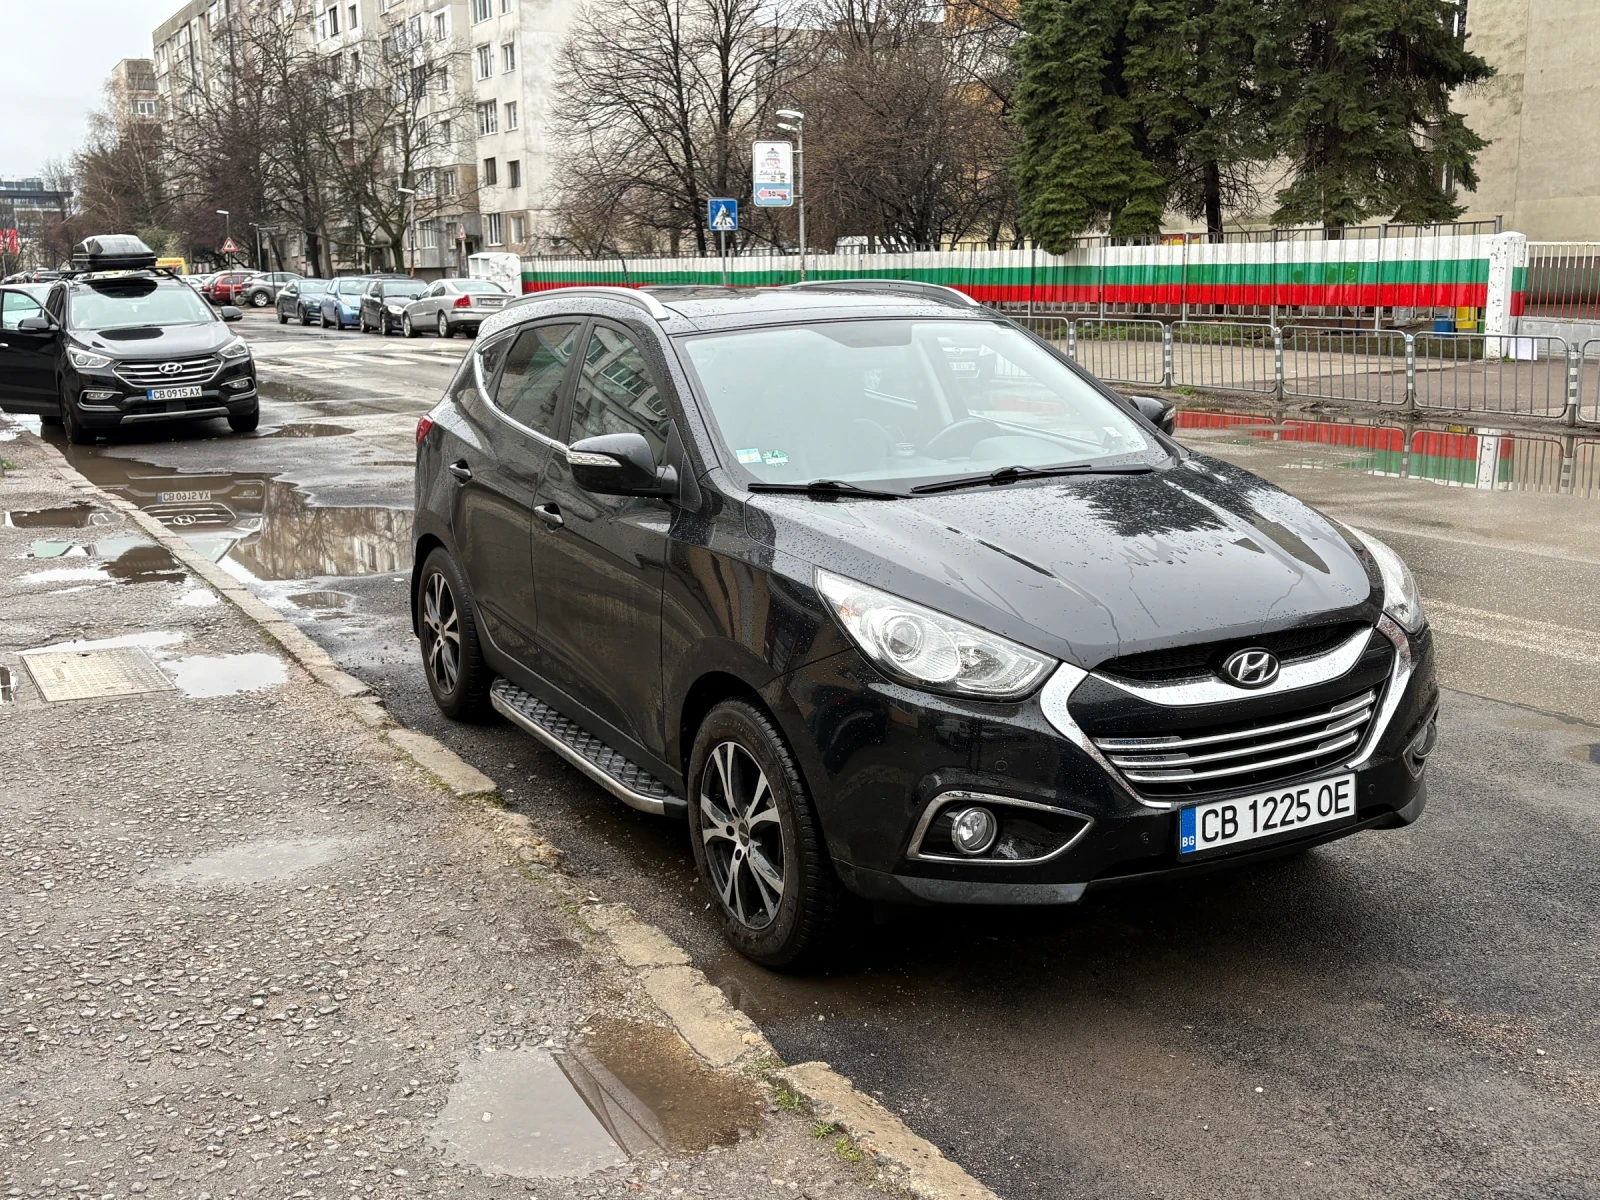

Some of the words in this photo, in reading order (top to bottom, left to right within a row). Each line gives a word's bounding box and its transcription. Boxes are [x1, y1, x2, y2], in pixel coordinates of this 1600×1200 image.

[153, 390, 165, 400] CB
[166, 388, 188, 398] 0915
[189, 387, 200, 397] AX
[1182, 836, 1195, 848] BG
[1201, 804, 1239, 843] CB
[1248, 788, 1311, 834] 1225
[1317, 779, 1351, 817] OE
